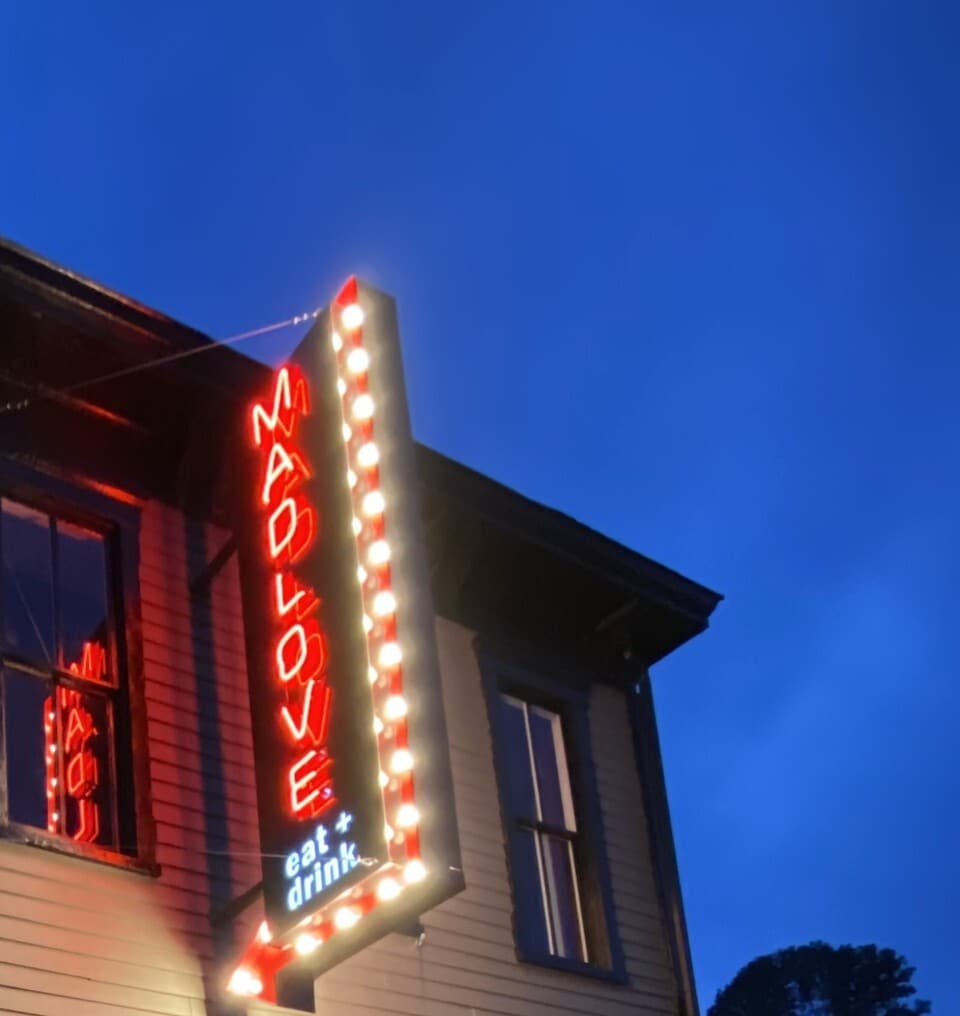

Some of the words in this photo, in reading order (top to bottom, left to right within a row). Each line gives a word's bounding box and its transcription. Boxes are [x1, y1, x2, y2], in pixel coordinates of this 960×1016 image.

[251, 367, 320, 812] MADLOVE
[285, 825, 329, 877] eat
[336, 811, 352, 834] +
[287, 842, 359, 911] drink
